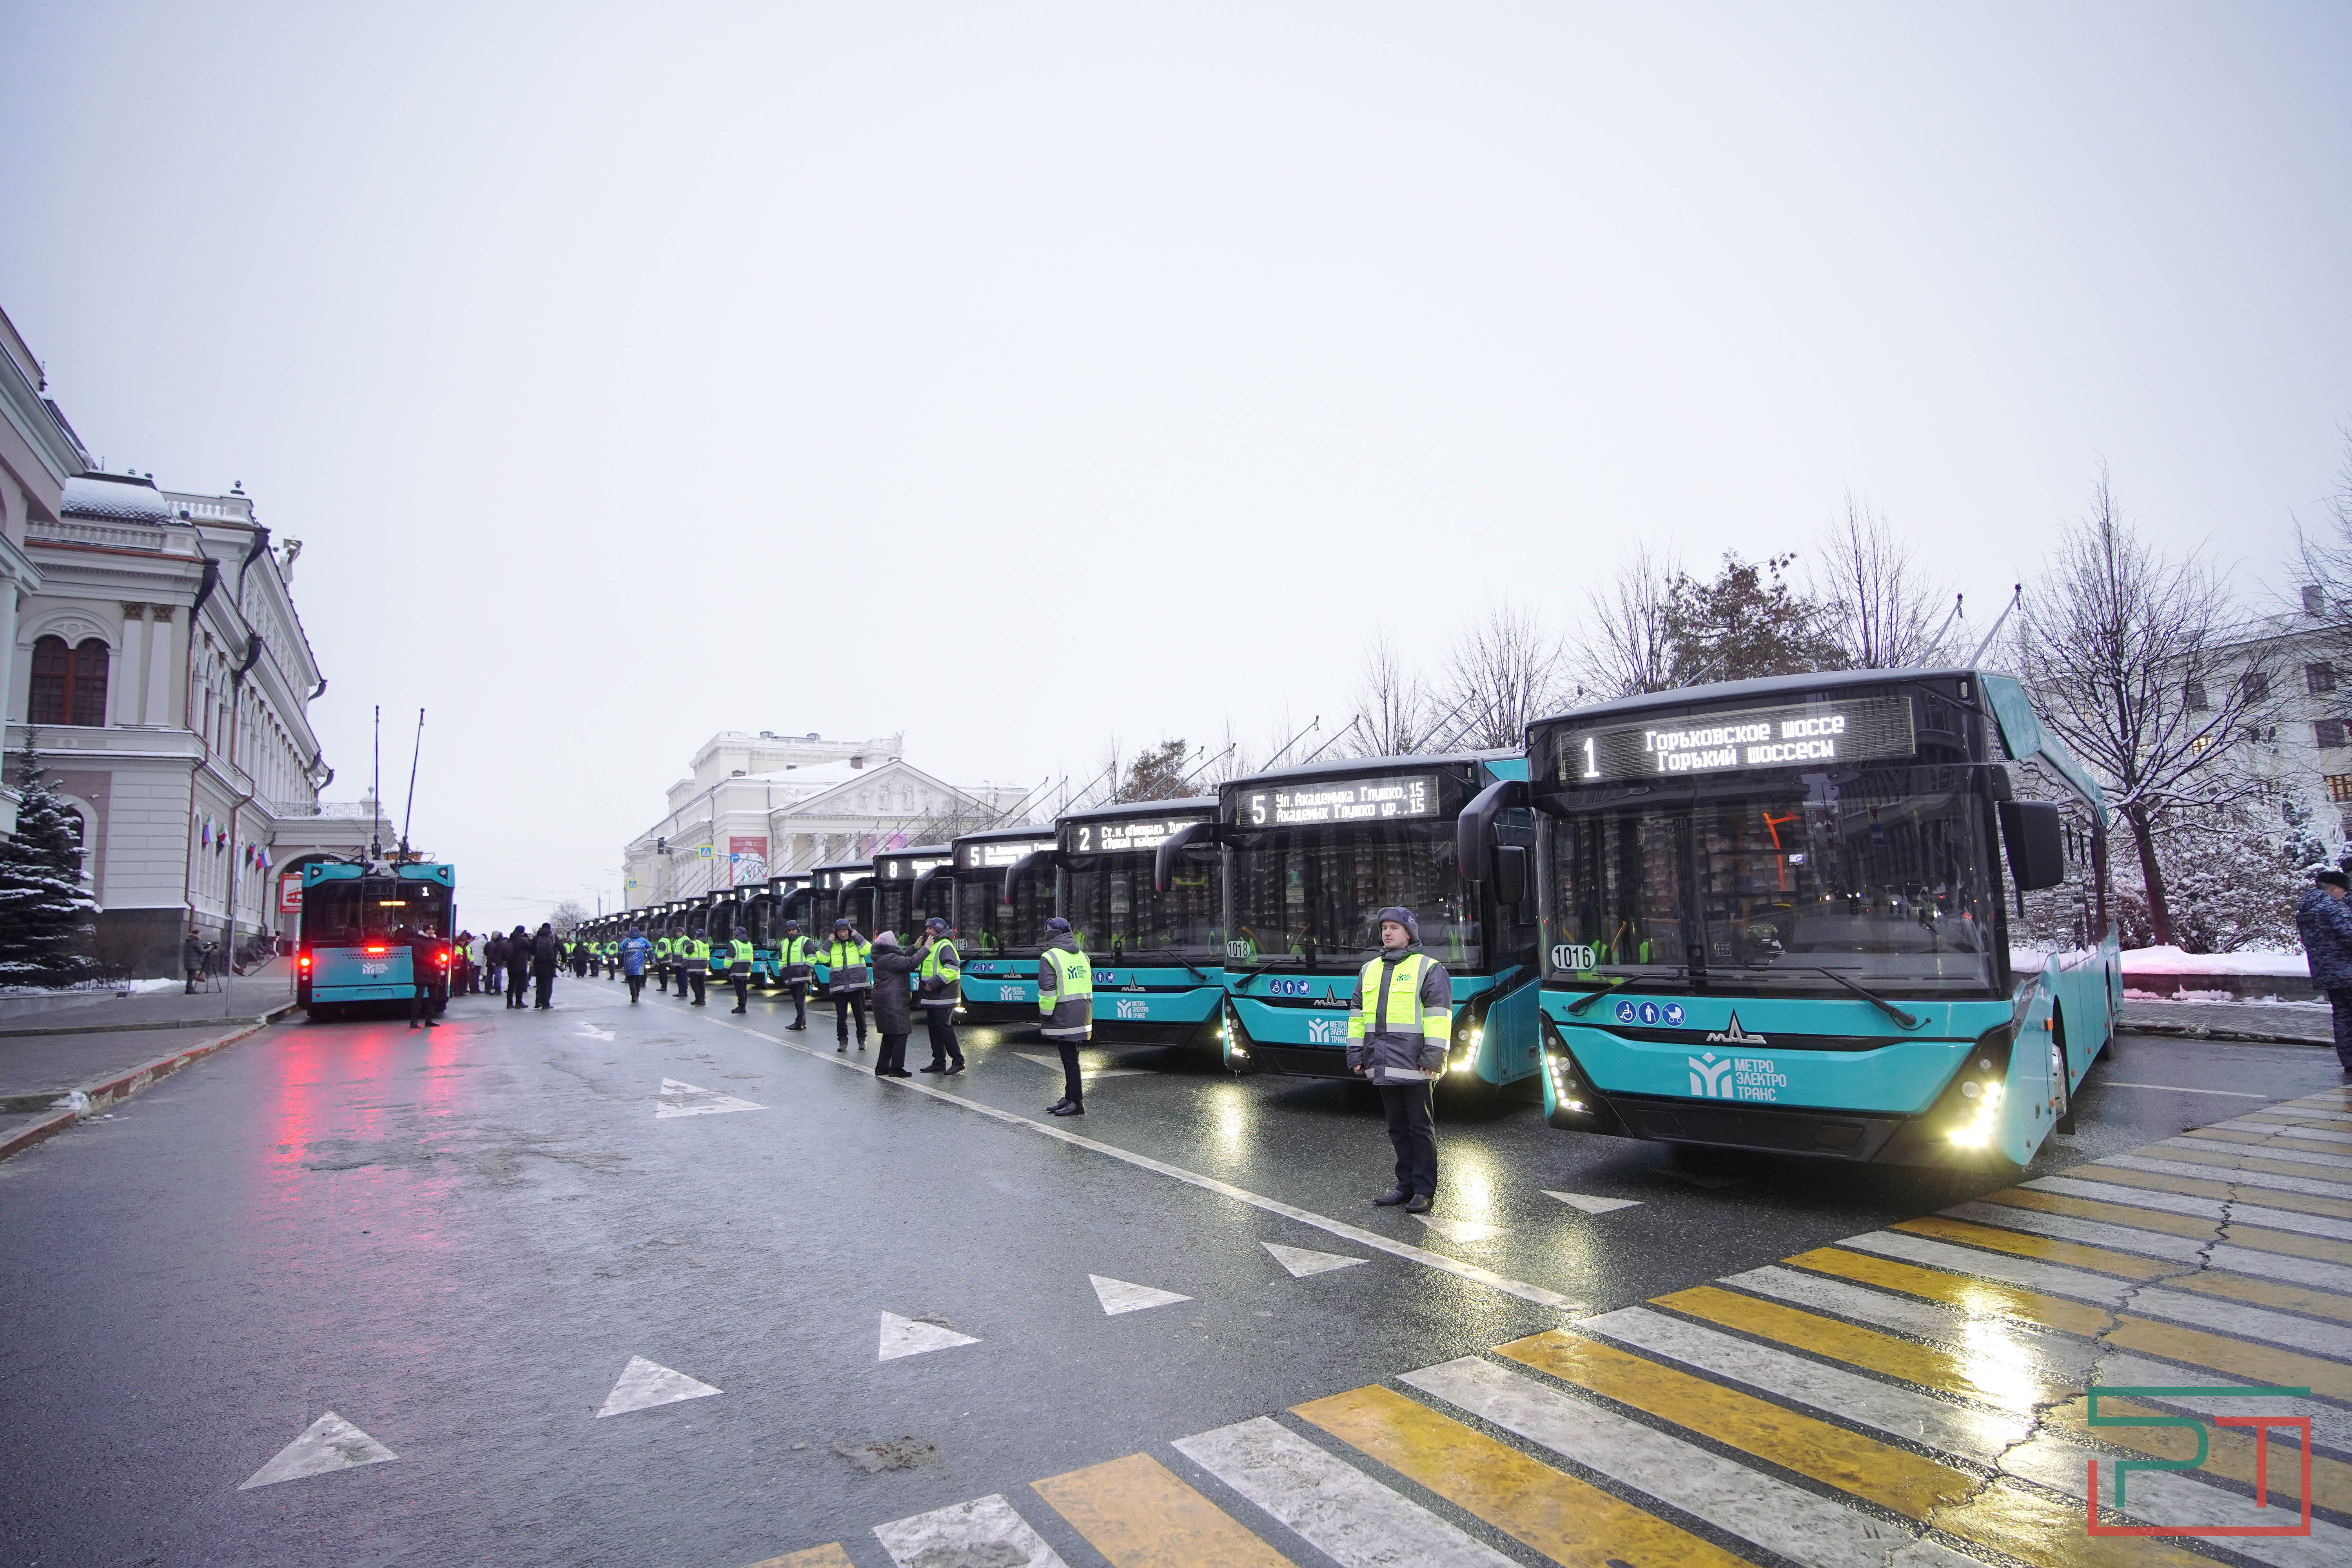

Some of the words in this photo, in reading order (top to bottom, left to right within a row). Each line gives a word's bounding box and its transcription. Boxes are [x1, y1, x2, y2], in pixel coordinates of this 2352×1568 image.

[1646, 724, 1771, 751] Горьковское
[1782, 716, 1845, 738] шоссе
[1584, 738, 1600, 778] 1
[1657, 745, 1737, 771] Горький
[1747, 739, 1835, 763] шоссесы
[1252, 795, 1265, 824] 5
[1276, 806, 1329, 822] Академик
[1334, 804, 1376, 819] Глушко
[1079, 828, 1090, 851] 2
[970, 847, 980, 866] 5
[889, 862, 897, 878] 8
[779, 882, 786, 894] 7
[824, 874, 831, 888] 1
[422, 886, 429, 897] 1
[955, 940, 966, 949] 1019
[1229, 942, 1248, 957] 1018
[1555, 947, 1591, 968] 1016
[1329, 1020, 1348, 1029] МЕТРО
[1706, 1015, 1767, 1044] МАЗ
[1734, 1058, 1774, 1073] МЕТРО
[1736, 1072, 1787, 1087] ЭЛЕКТРО
[1737, 1086, 1776, 1102] ТРАНС
